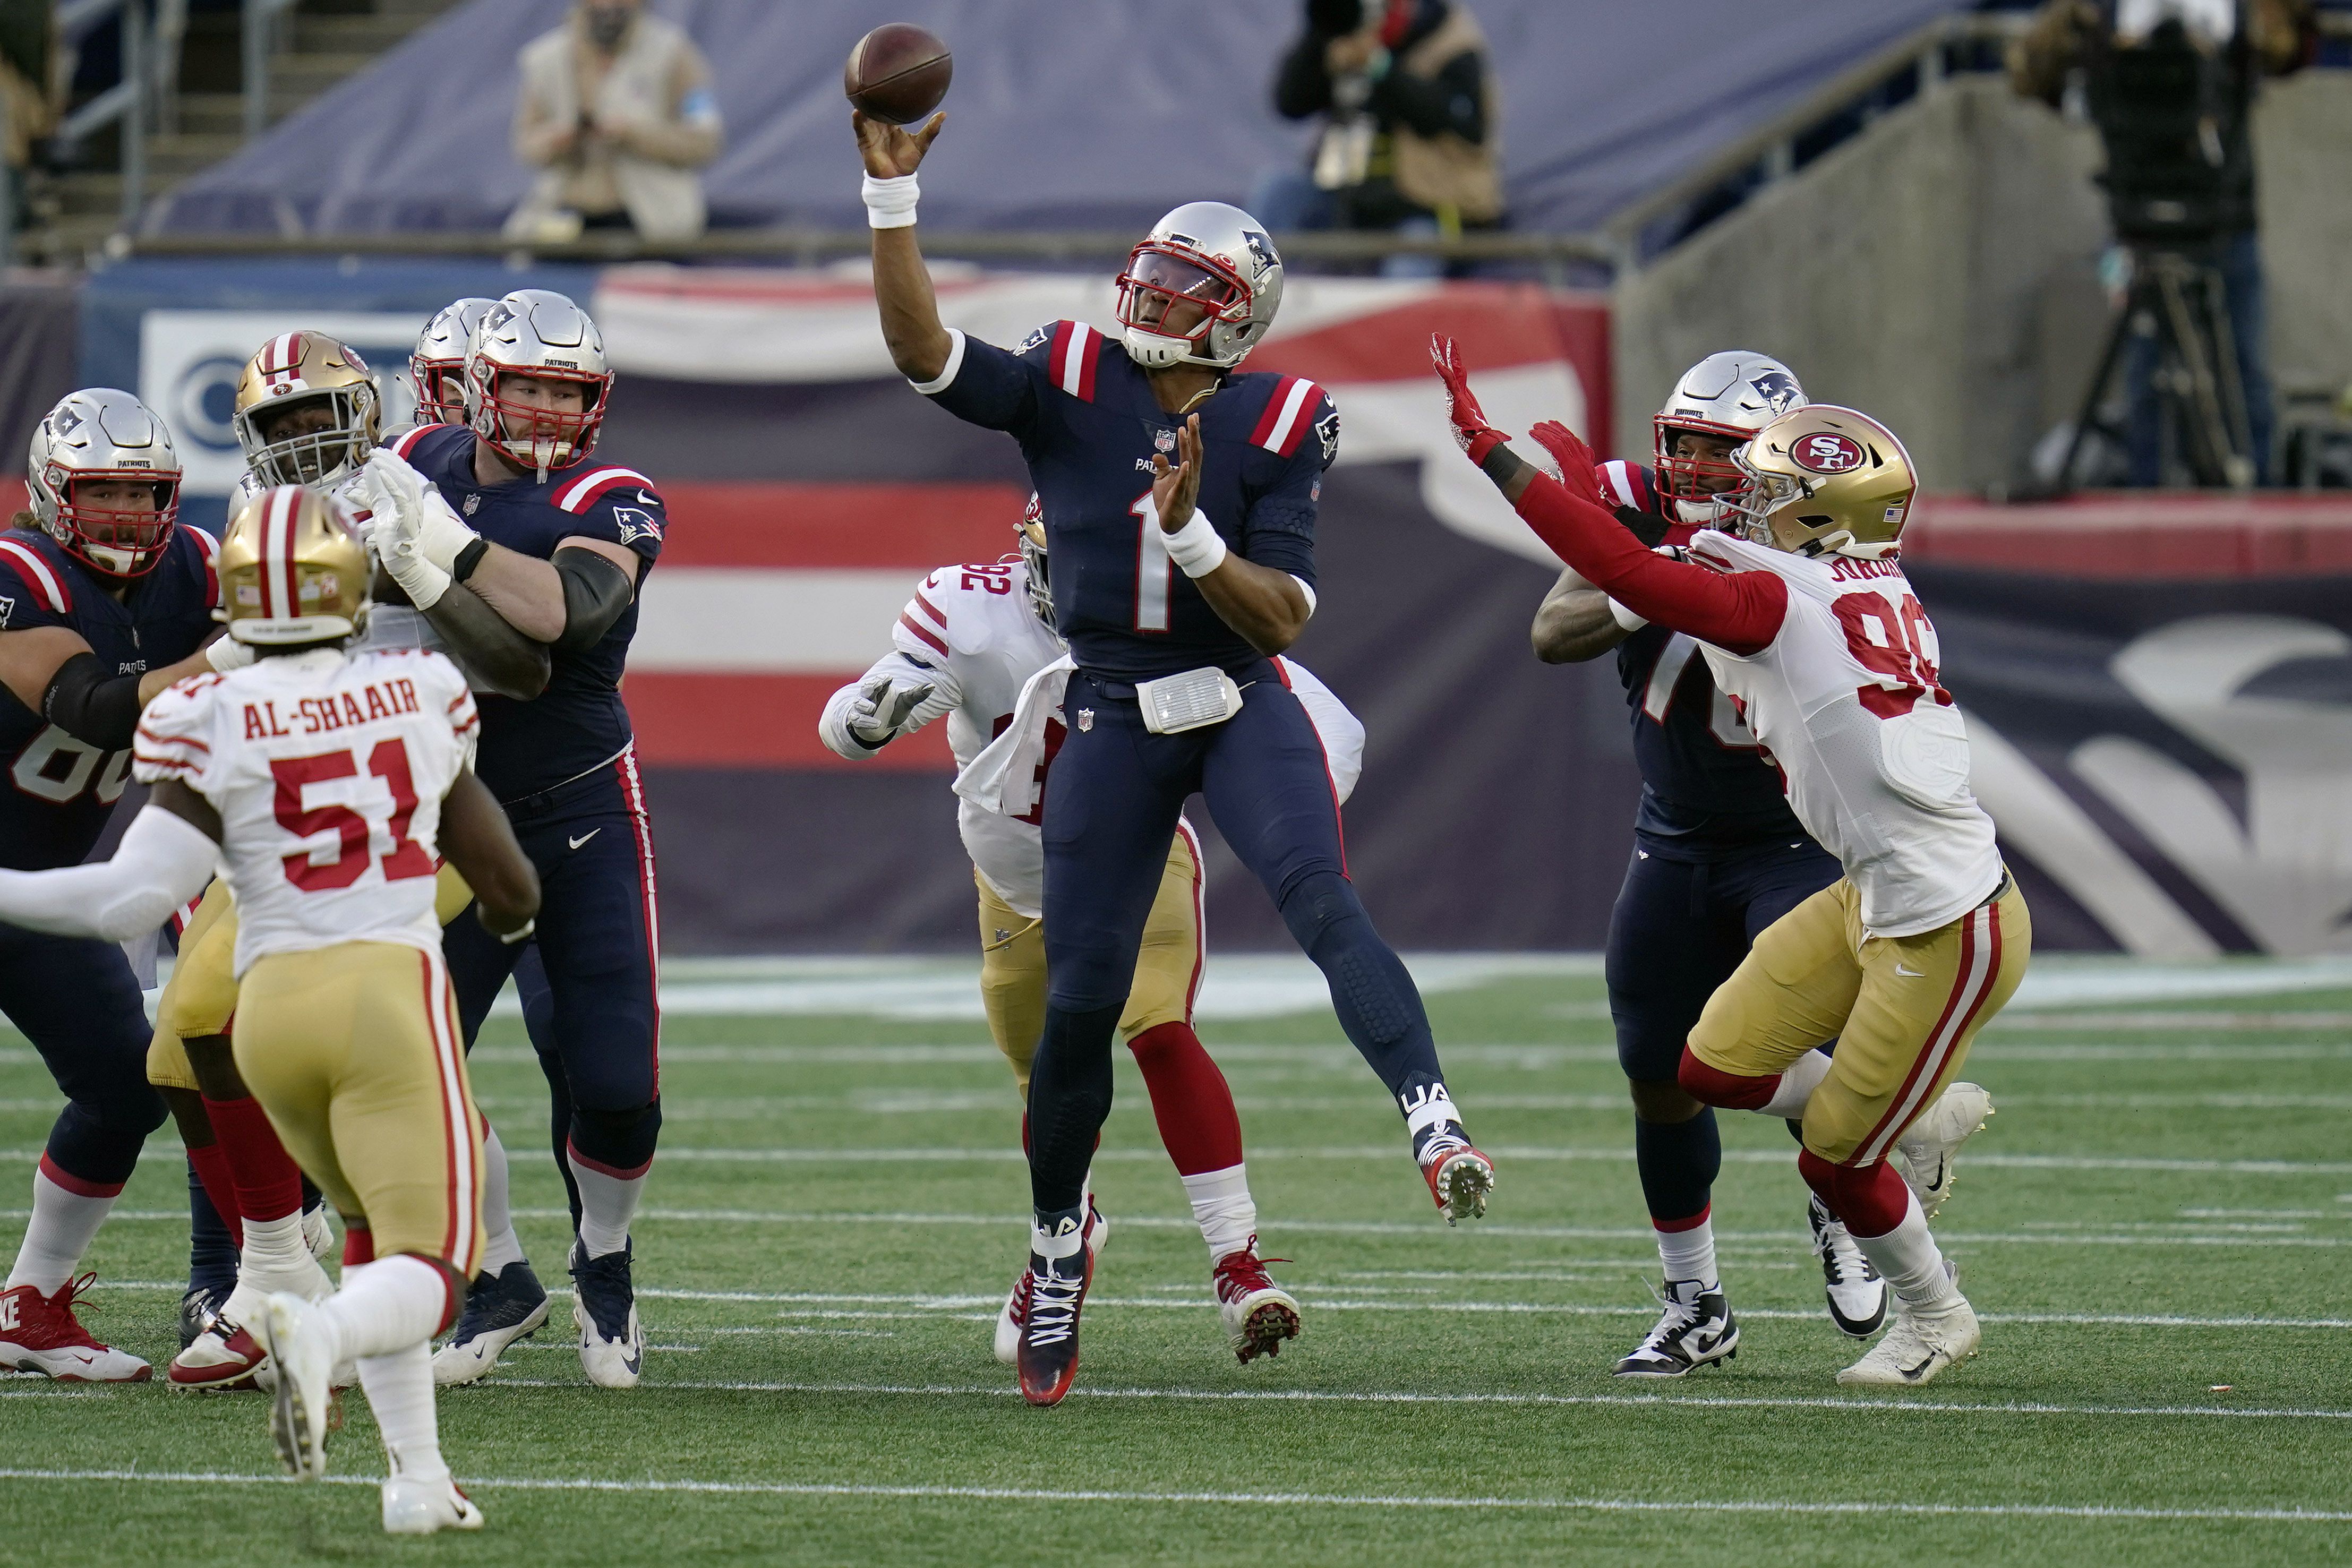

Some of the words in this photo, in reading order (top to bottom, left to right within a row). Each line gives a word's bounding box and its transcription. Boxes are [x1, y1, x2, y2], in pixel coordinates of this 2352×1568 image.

[545, 358, 578, 370] PATRIOTS
[1158, 439, 1171, 448] NFL
[1809, 436, 1853, 469] SF
[1129, 489, 1172, 632] 1
[243, 678, 420, 740] AL-SHAAIR
[1080, 718, 1091, 727] NFL
[269, 736, 437, 893] 51
[1401, 1083, 1450, 1113] UA
